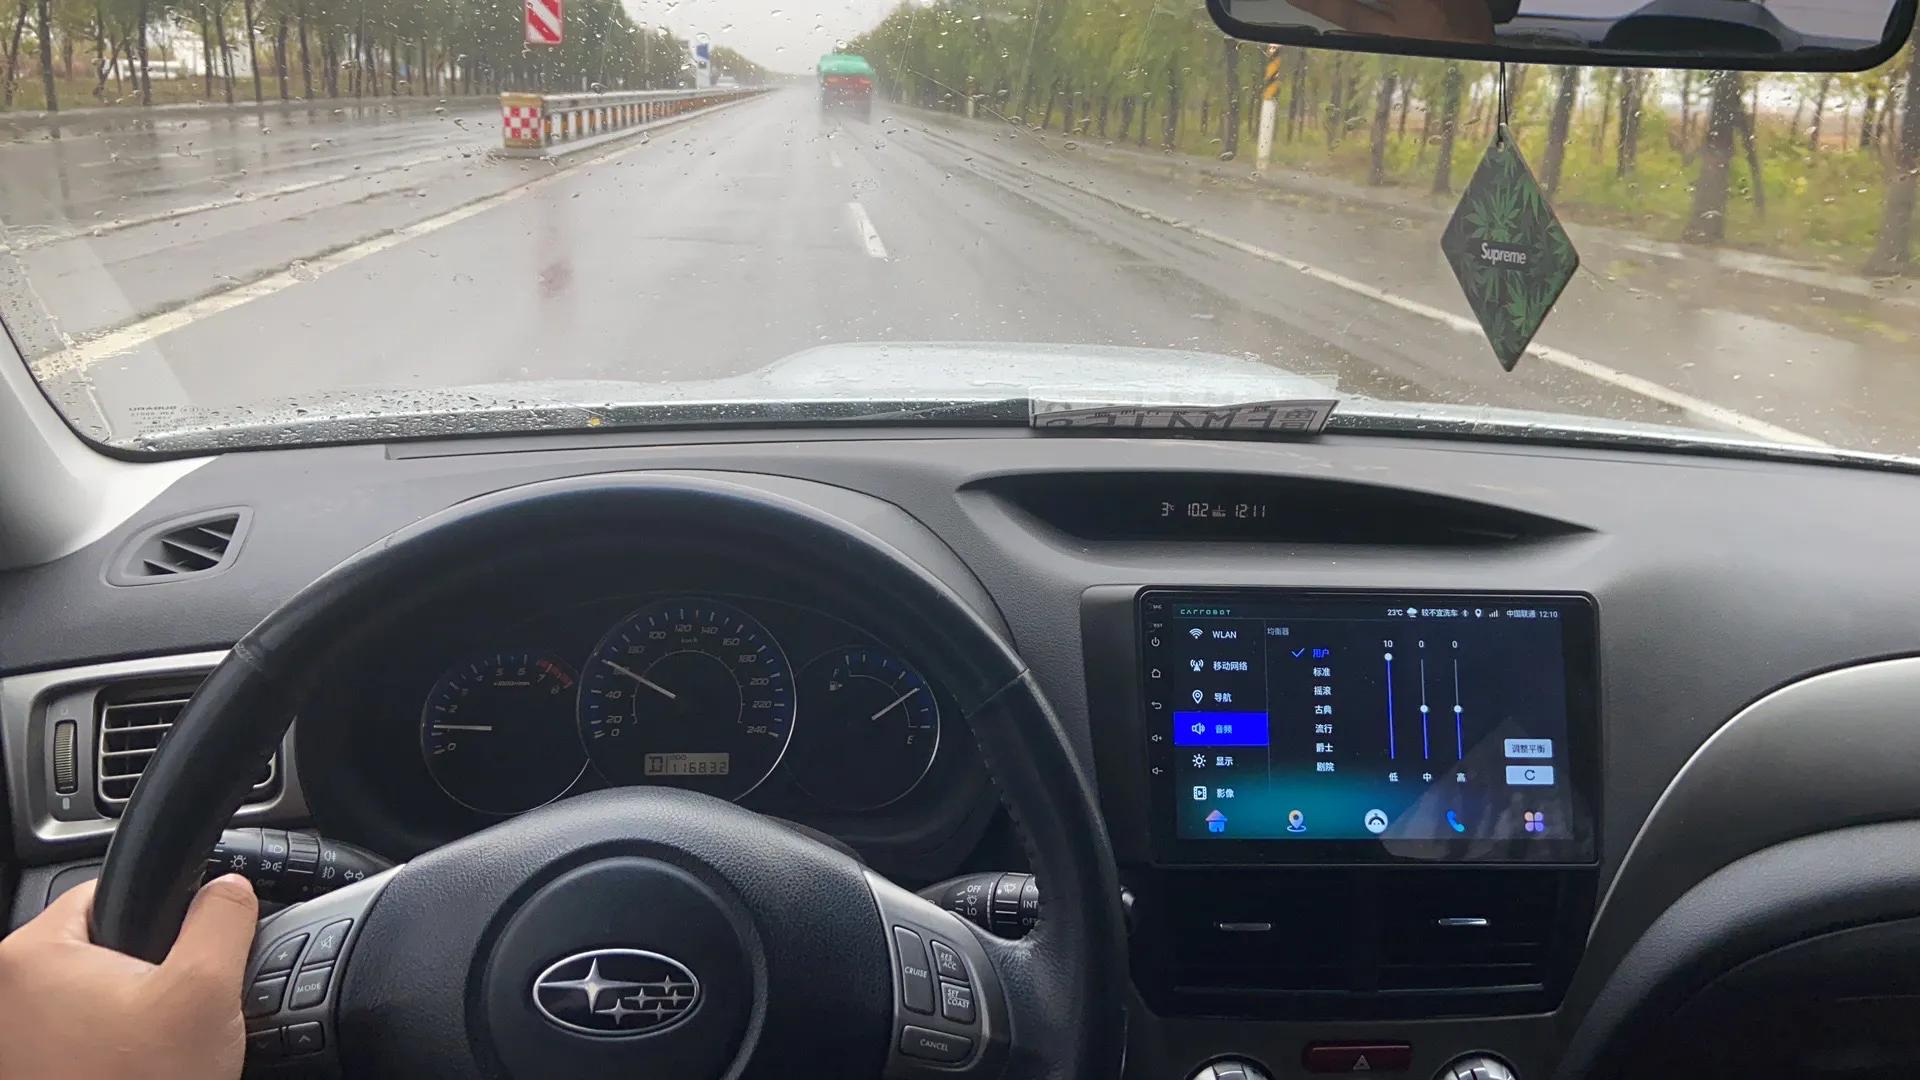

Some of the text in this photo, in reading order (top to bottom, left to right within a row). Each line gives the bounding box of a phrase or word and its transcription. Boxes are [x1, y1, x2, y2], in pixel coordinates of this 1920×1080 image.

[1481, 242, 1527, 265] Supreme
[1506, 609, 1558, 619] 中国联通 12:10
[674, 624, 692, 632] 120
[701, 626, 719, 635] 140
[649, 631, 666, 640] 100
[1212, 630, 1237, 640] WLAN
[722, 638, 740, 646] 160
[1384, 639, 1458, 649] 10 0 0
[738, 654, 757, 664] 180
[1312, 649, 1330, 659] 用户
[1213, 661, 1248, 671] 移动网络
[1313, 667, 1331, 677] 标准
[750, 677, 769, 686] 200
[605, 690, 622, 699] 40
[1314, 686, 1332, 696] 摇滚
[1214, 692, 1232, 703] 导航
[752, 700, 772, 709] 220
[1314, 705, 1332, 715] 古典
[606, 715, 622, 724] 20
[611, 728, 620, 736] 0
[747, 725, 767, 734] 240
[1215, 724, 1233, 734] 音频
[1315, 724, 1333, 734] 流行
[907, 735, 913, 745] E
[447, 742, 457, 751] 0
[1316, 743, 1334, 753] 爵士
[1512, 744, 1546, 754] 调整平衡
[1216, 756, 1234, 767] 显示
[1317, 762, 1335, 773] 剧院
[1389, 772, 1466, 783] 低 中 高
[1216, 788, 1235, 799] 影像
[967, 885, 982, 893] OFF
[1023, 900, 1038, 909] INT
[943, 961, 958, 971] ACC
[904, 965, 928, 979] CRUISE
[296, 983, 321, 994] MODE
[946, 989, 959, 999] SET
[947, 998, 970, 1009] COAST
[919, 1038, 949, 1052] CANCEL
